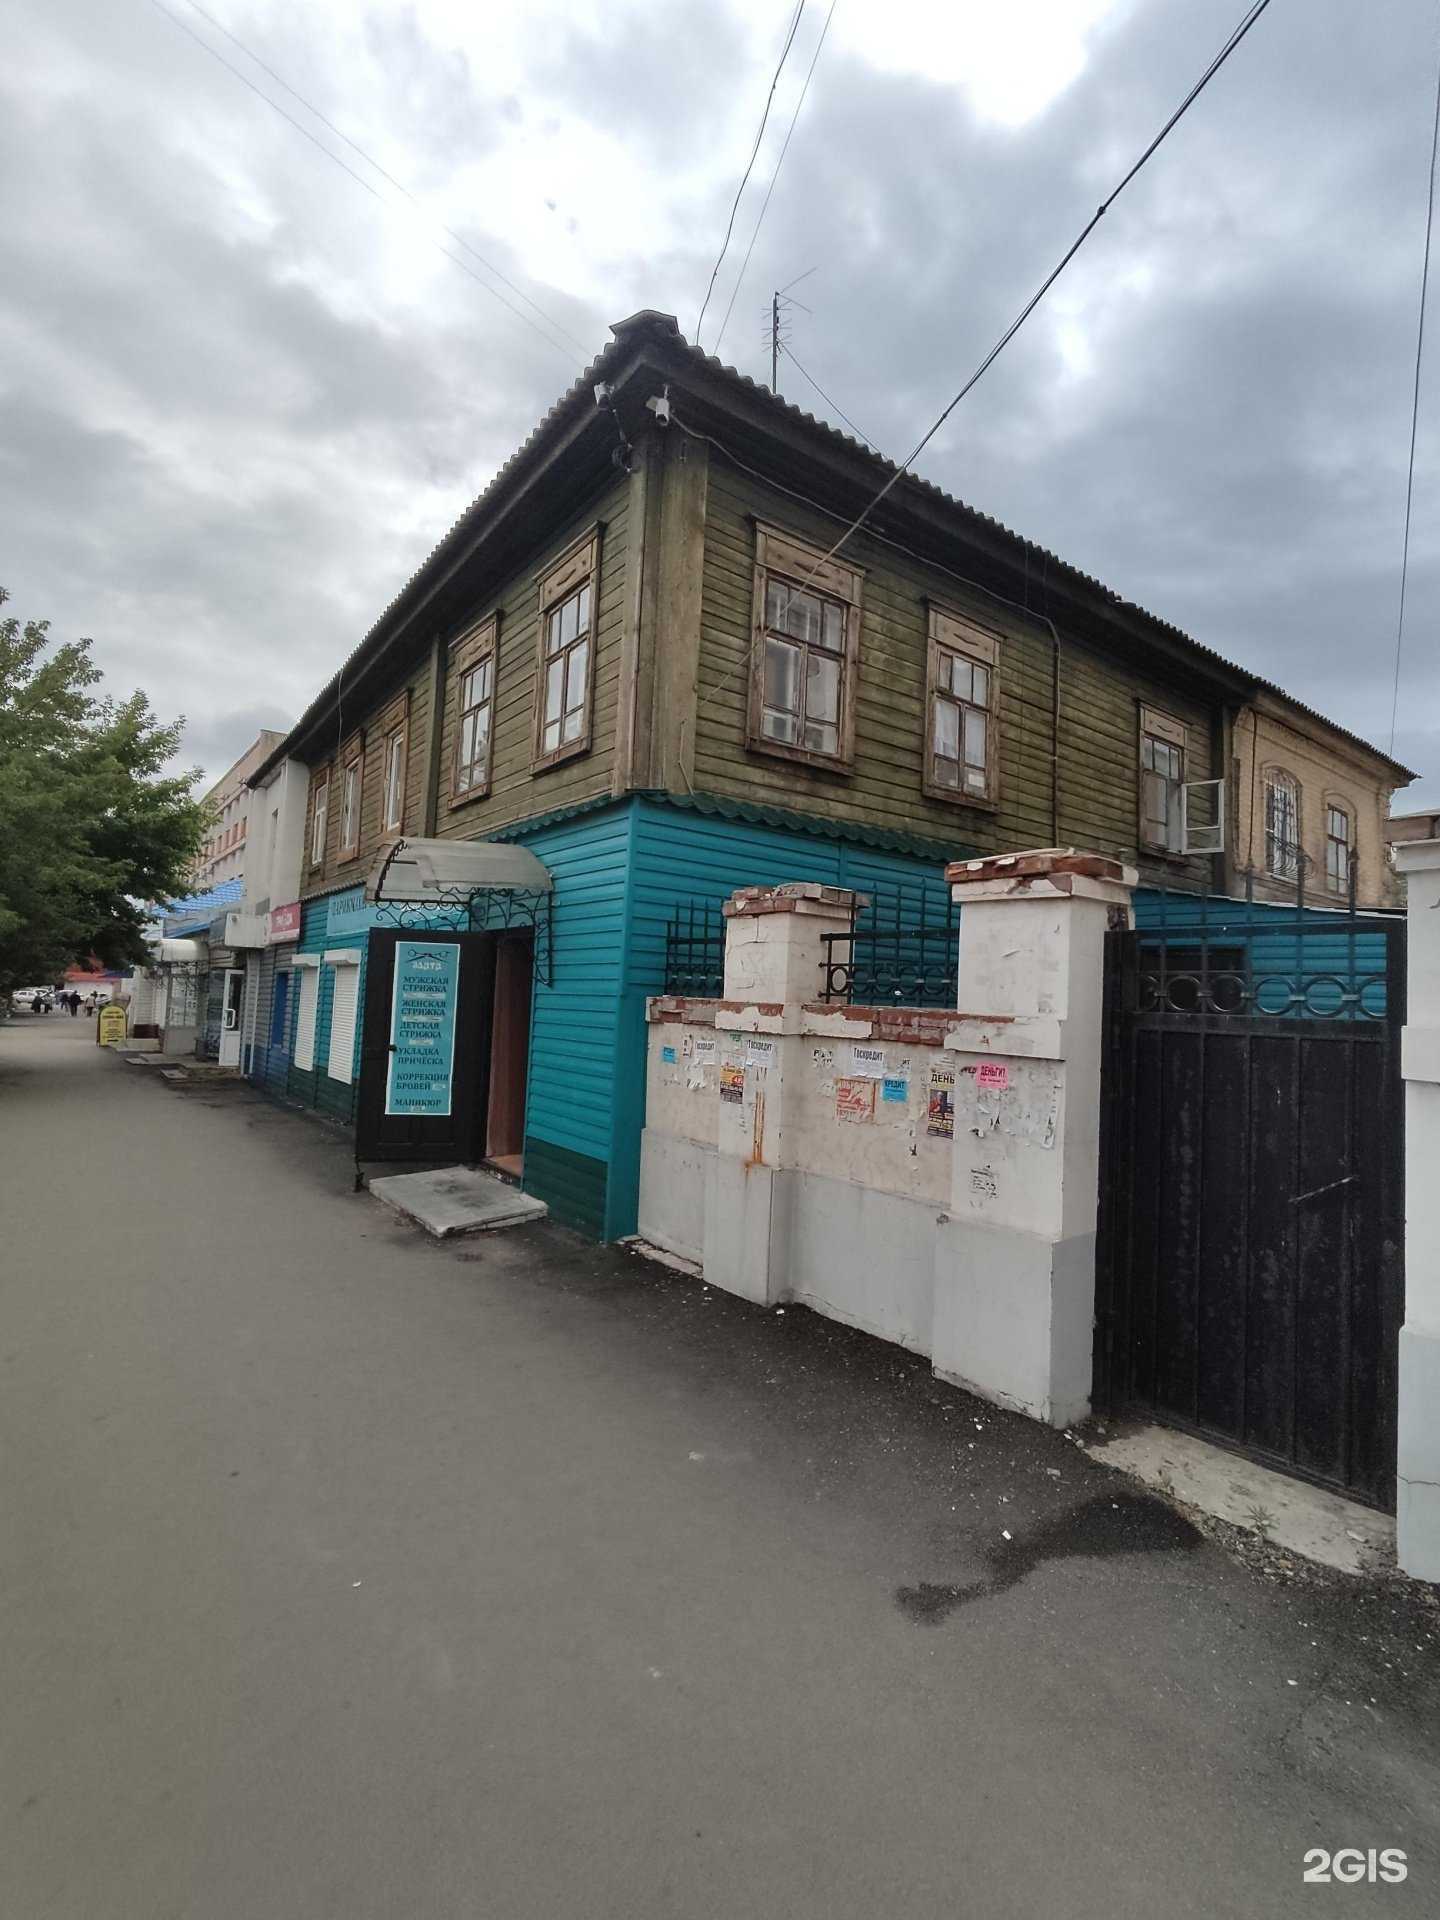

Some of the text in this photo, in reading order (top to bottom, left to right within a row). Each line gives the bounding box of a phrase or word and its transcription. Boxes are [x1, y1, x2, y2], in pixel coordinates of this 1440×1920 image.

[403, 976, 449, 985] МУЖСКАЯ
[402, 984, 447, 992] СТРИЖКА
[402, 1000, 446, 1008] ЖЕНСКАЯ
[401, 1008, 445, 1016] СТРИЖКА
[400, 1021, 439, 1030] ДЕТСКАЯ
[399, 1030, 441, 1039] СТРИЖКА
[398, 1047, 440, 1056] УКЛАДКА
[398, 1056, 444, 1065] ПРИЧЕСКА
[397, 1072, 449, 1081] КОРРЕКЦИЯ
[396, 1081, 431, 1090] БРОВЕЙ
[395, 1098, 442, 1107] МАНИКЮР
